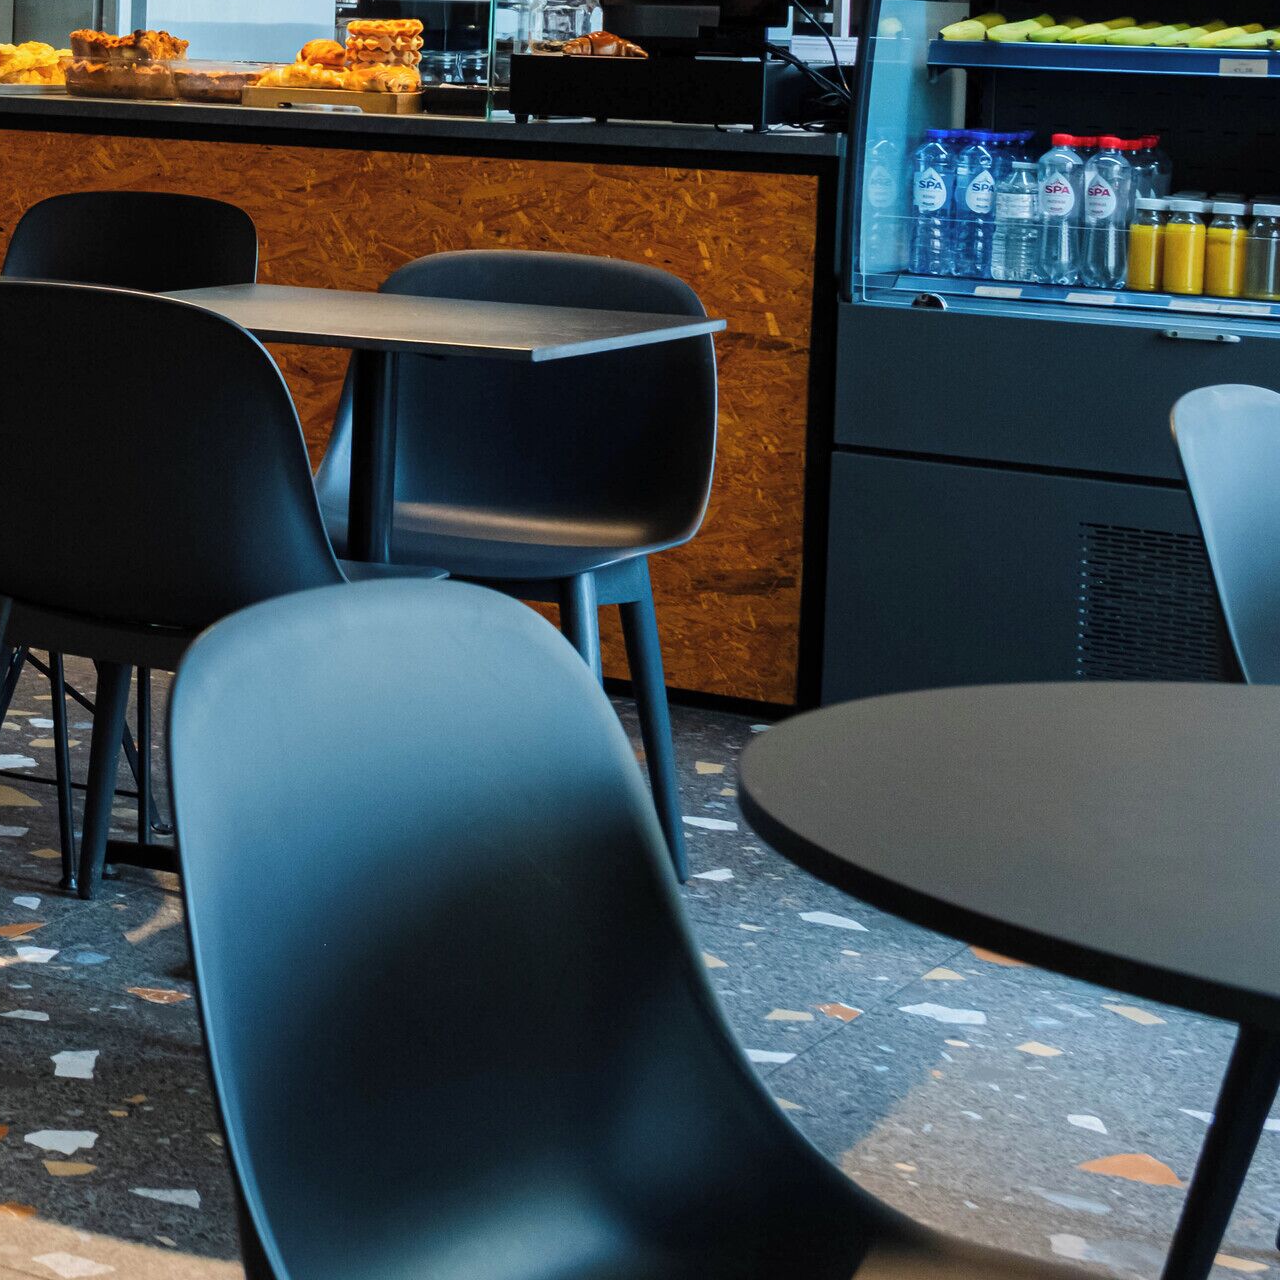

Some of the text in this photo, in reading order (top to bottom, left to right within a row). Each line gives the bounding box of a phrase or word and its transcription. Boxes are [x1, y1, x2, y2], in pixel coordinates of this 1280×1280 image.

[919, 180, 943, 190] SPA
[972, 182, 994, 192] SPA
[1045, 185, 1070, 194] SPA
[1087, 187, 1111, 197] SPA
